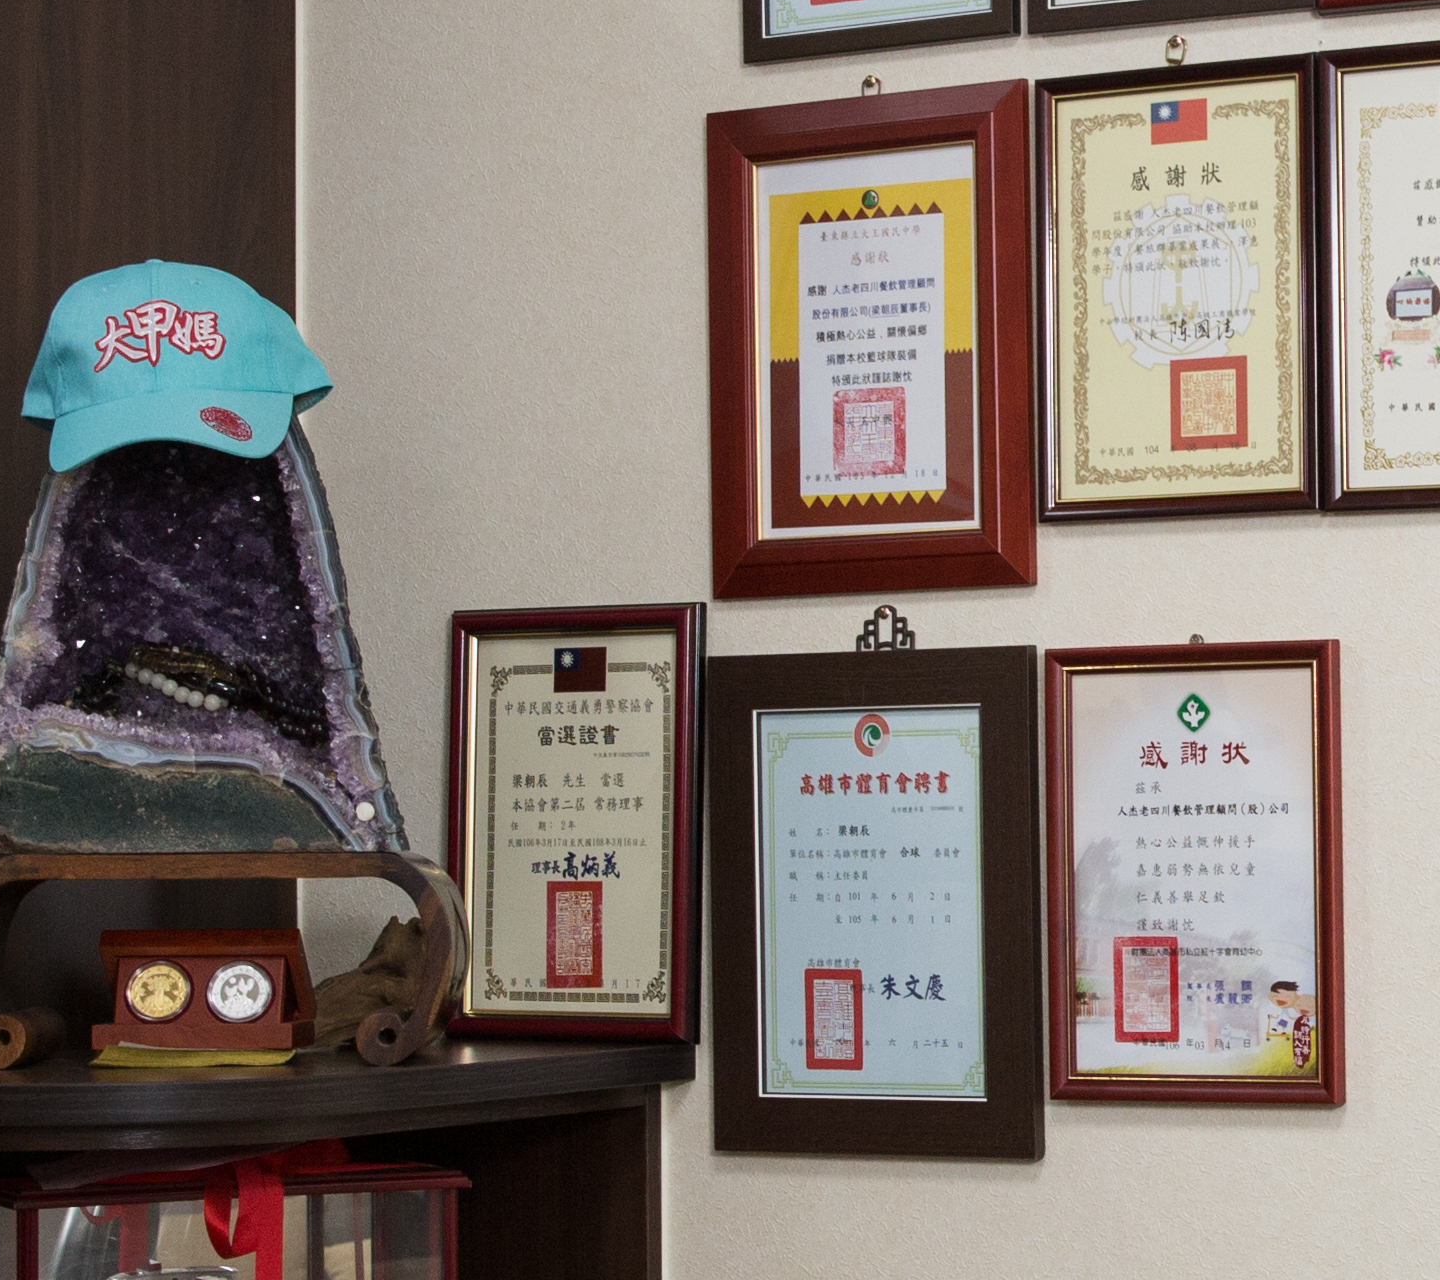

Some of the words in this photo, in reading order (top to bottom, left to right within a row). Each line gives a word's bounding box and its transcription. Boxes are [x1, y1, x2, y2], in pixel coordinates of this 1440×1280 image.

[1130, 162, 1222, 191] 感謝狀
[1151, 200, 1259, 218] 人杰老四川餐飲管理顧
[1092, 226, 1166, 240] 問股份有限公司
[851, 251, 890, 266] 感謝狀
[832, 277, 935, 295] 人杰老四川餐飲管理顧問
[94, 299, 227, 372] 大甲媽
[826, 349, 917, 366] 捐贈本校籃球隊裝備
[504, 698, 654, 716] 中華民國交通義勇警察協會
[538, 724, 619, 747] 當選證書
[1139, 741, 1250, 770] 感謝狀
[512, 774, 548, 788] 梁朝辰
[562, 773, 586, 788] 先生
[600, 772, 624, 788] 當選
[800, 770, 950, 796] 高雄市體育會聘書
[512, 798, 586, 812] 本協會第二屆
[595, 796, 644, 812] 常務理事
[838, 825, 870, 837] 梁朝辰
[1135, 835, 1256, 850] 熱心公益慨伸援手
[899, 846, 920, 858] 合球
[934, 847, 960, 859] 委員會
[1136, 862, 1256, 877] 嘉惠弱勢無依兒童
[1136, 918, 1195, 932] 謹致謝忱
[807, 957, 860, 968] 高雄市體育會
[880, 974, 946, 1001] 朱文慶
